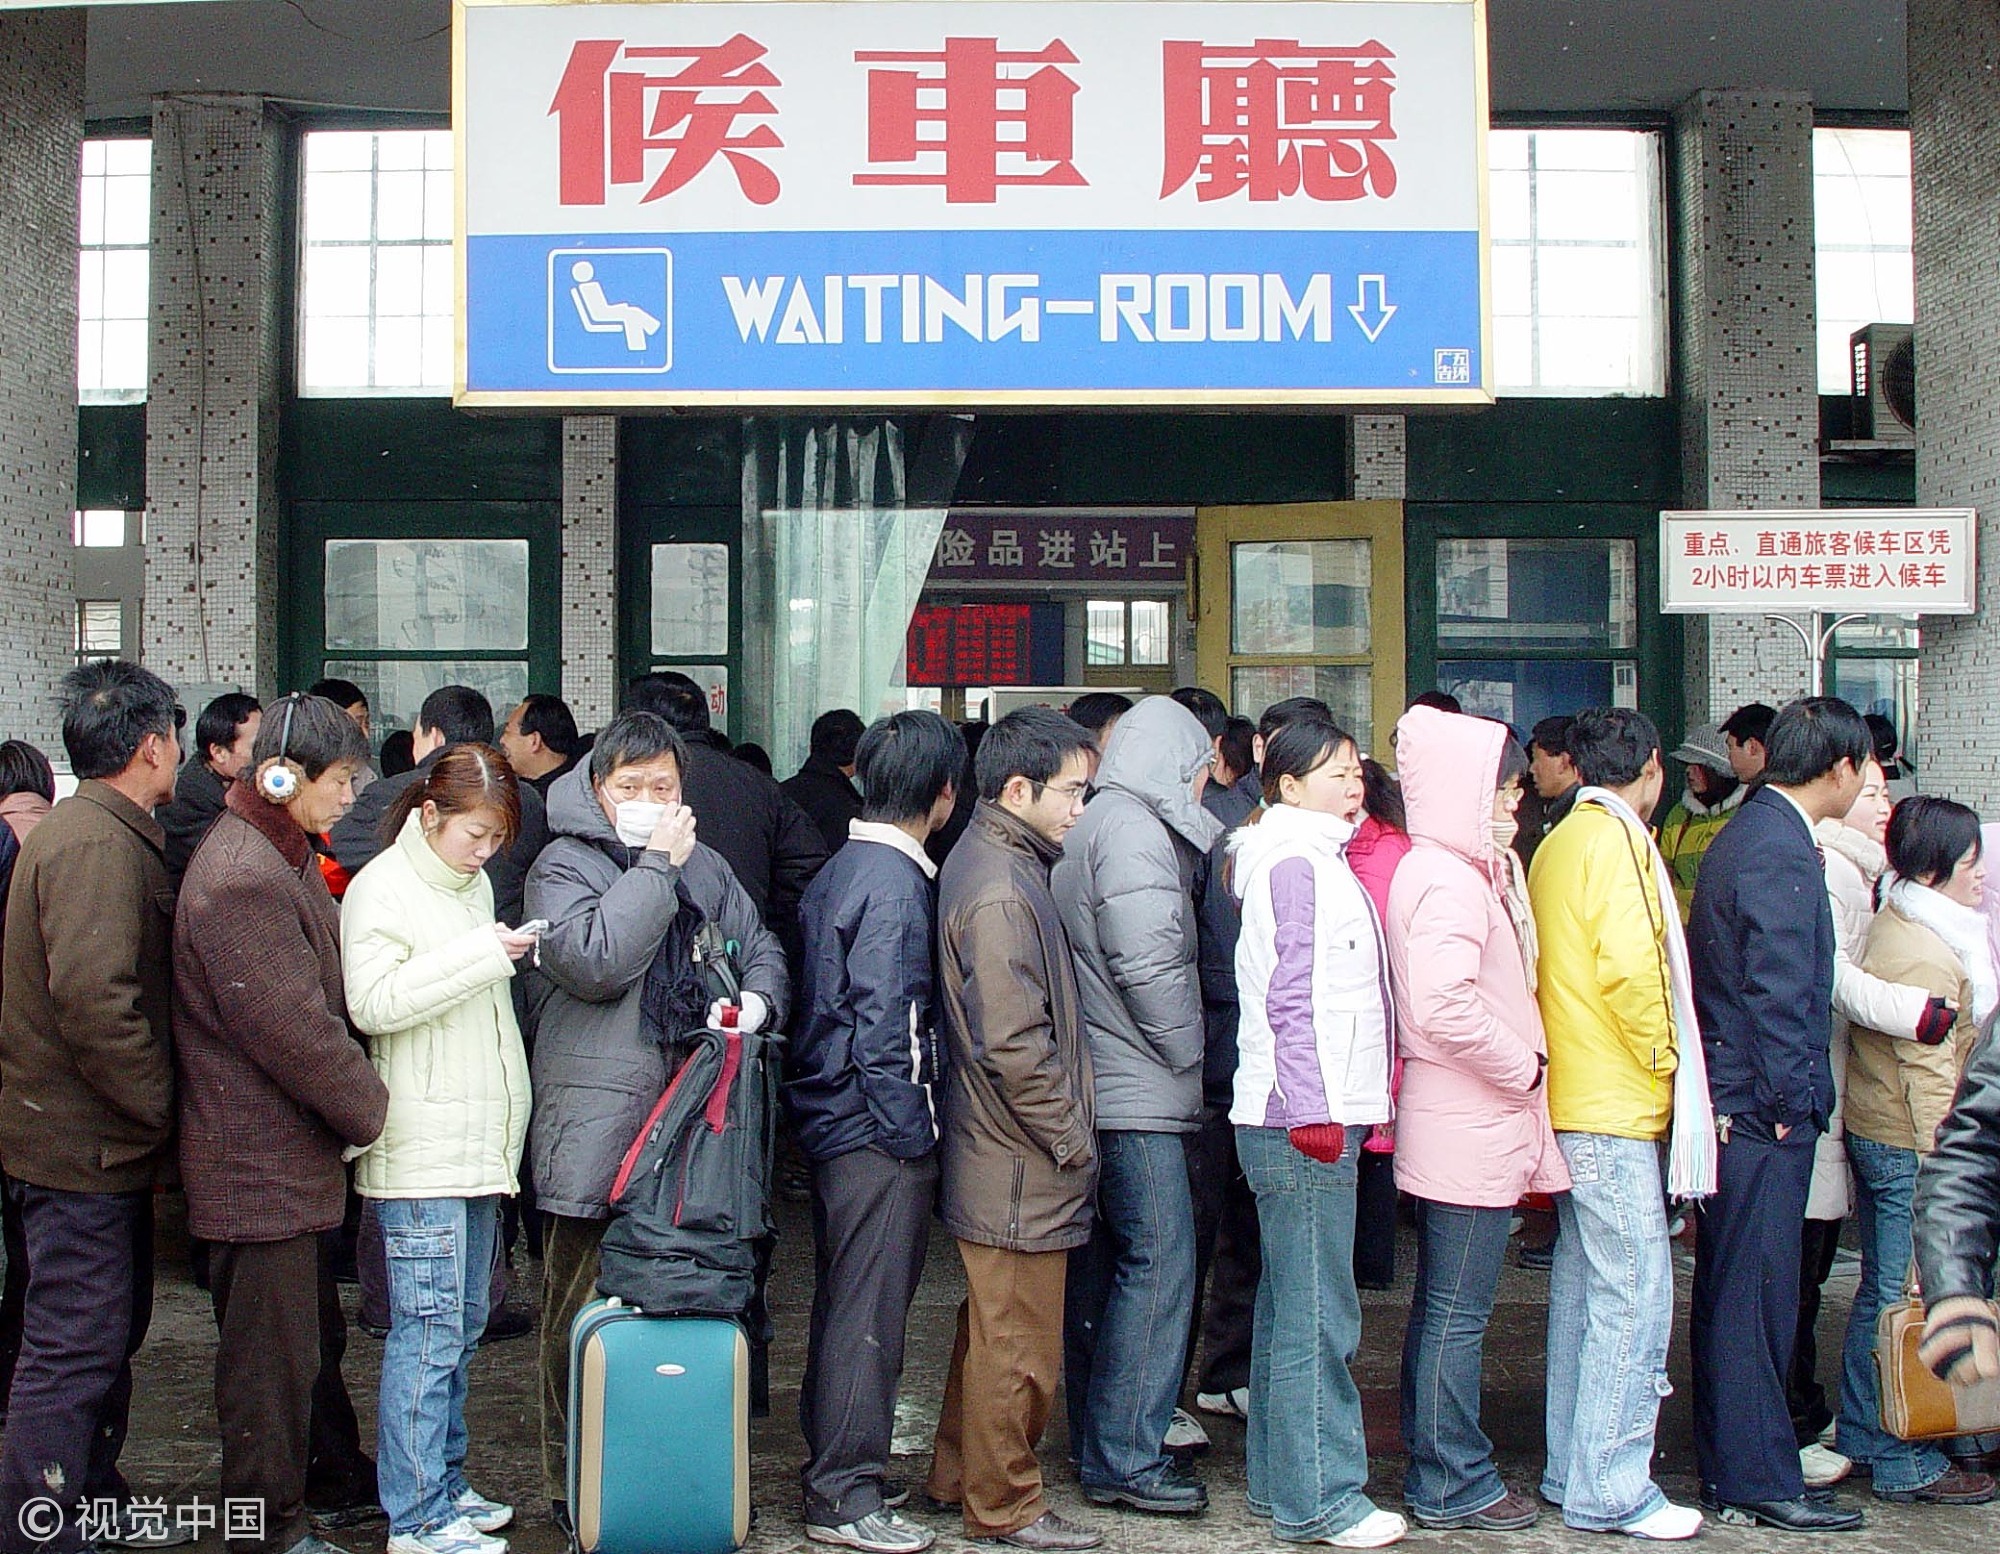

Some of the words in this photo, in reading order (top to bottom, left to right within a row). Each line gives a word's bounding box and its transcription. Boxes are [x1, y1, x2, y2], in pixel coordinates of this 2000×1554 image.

[549, 33, 1398, 207] 候車廳
[721, 272, 1333, 345] WAITING-ROOM
[937, 528, 1177, 568] 险品进站上
[1683, 529, 1951, 557] 重点、直通旅客候车区凭
[1691, 562, 1947, 590] 2小时以内车票进入候车
